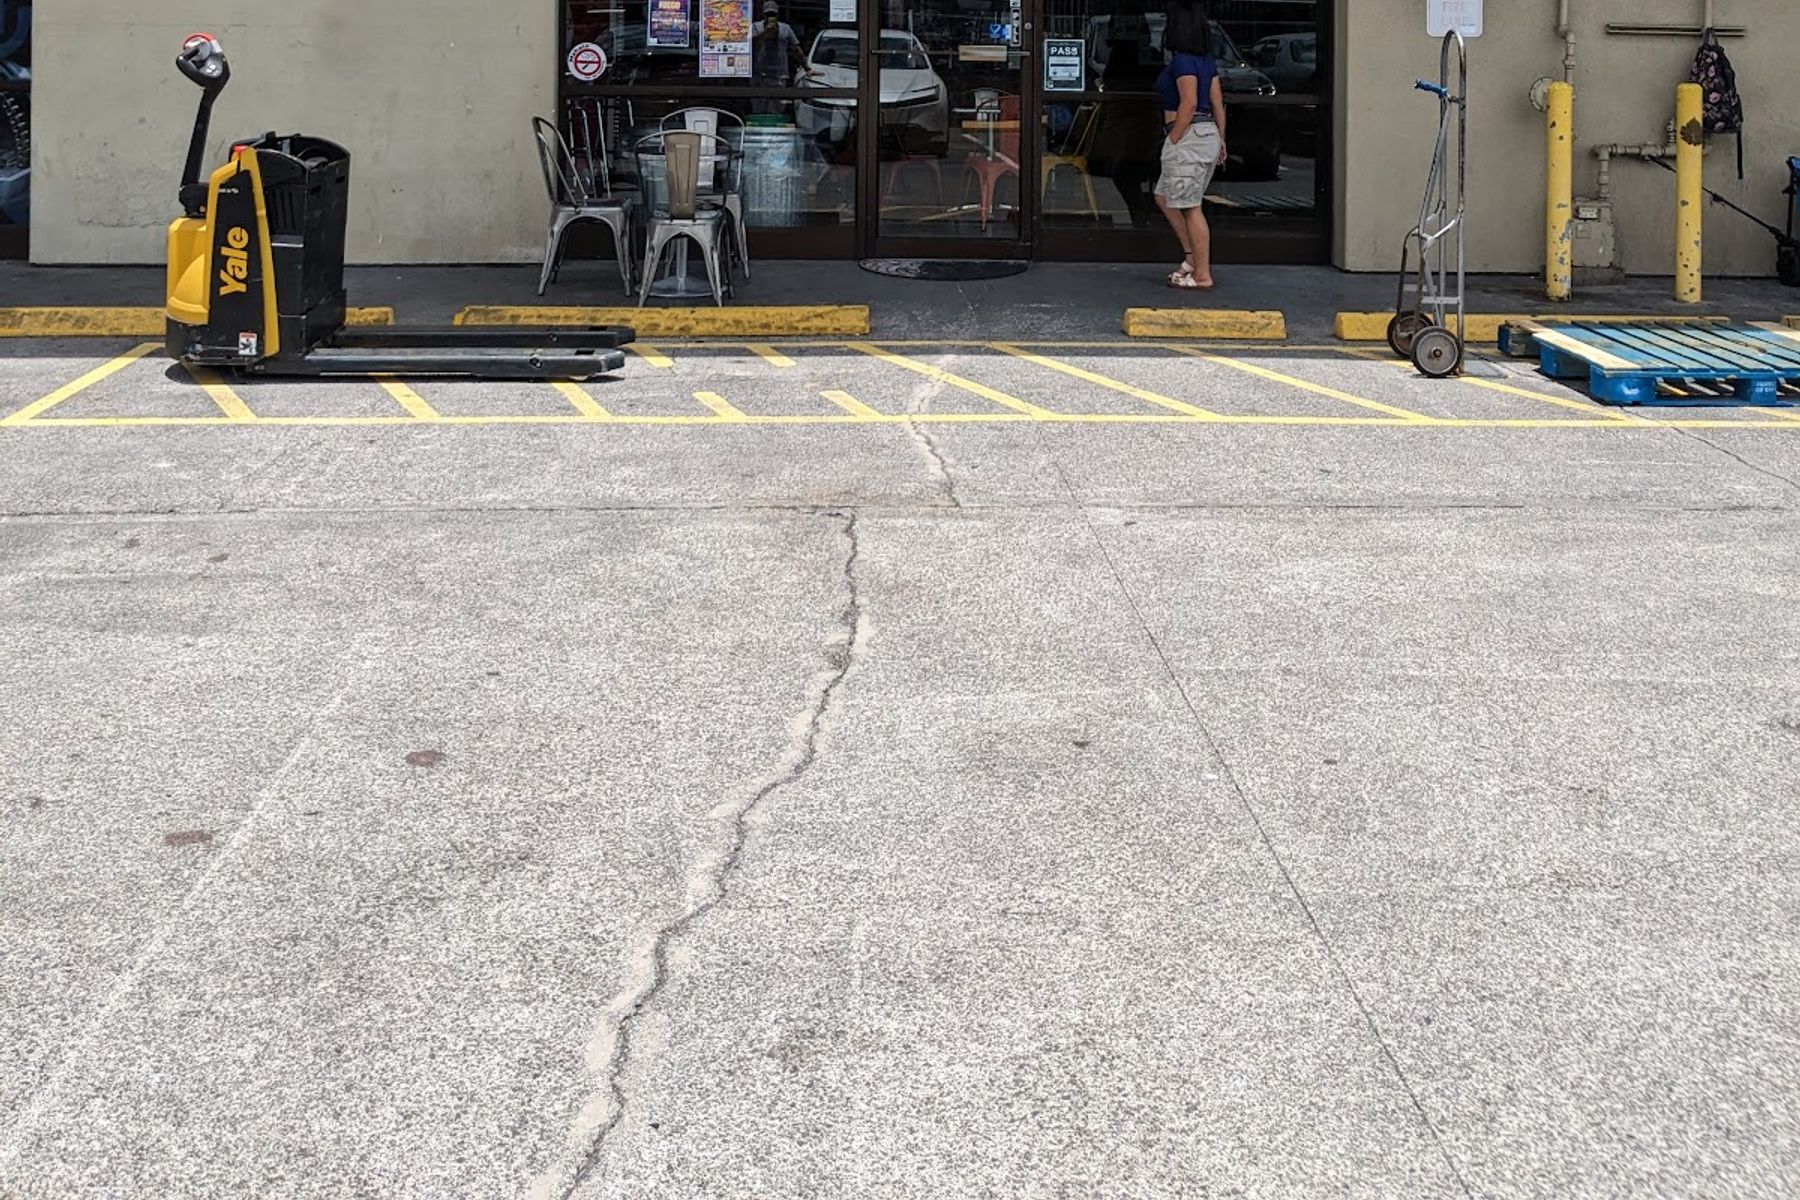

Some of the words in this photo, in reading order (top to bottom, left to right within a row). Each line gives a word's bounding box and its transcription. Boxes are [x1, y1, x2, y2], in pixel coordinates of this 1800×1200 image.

[1442, 1, 1466, 12] FIRE
[1050, 47, 1078, 55] PASS
[218, 226, 249, 296] Yale
